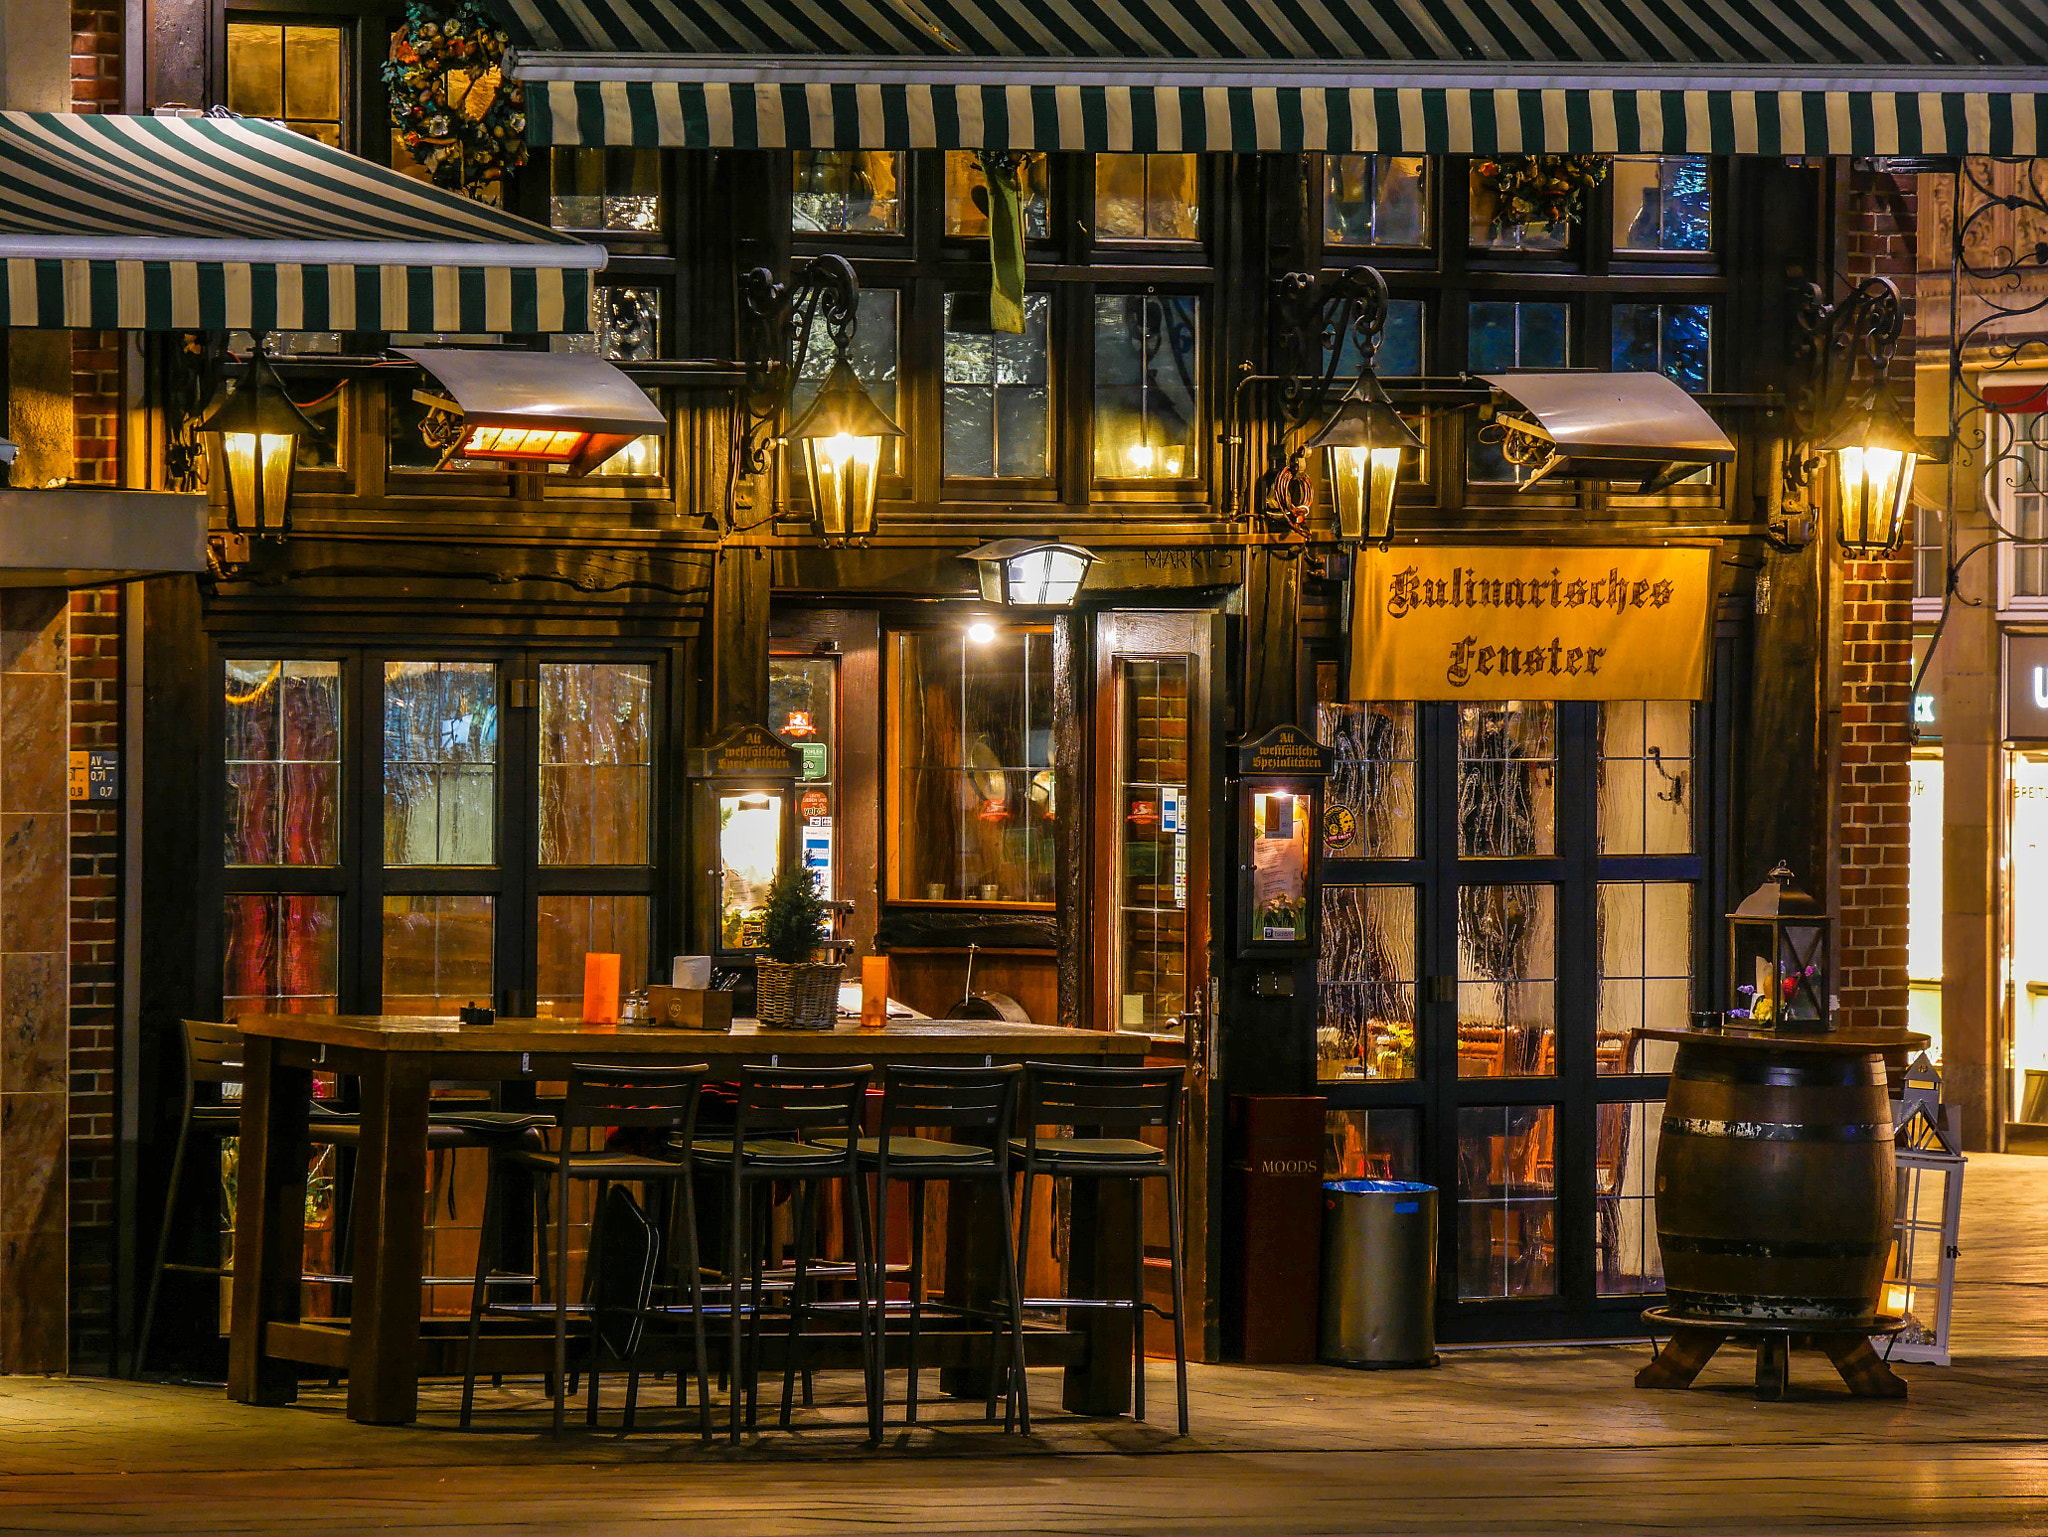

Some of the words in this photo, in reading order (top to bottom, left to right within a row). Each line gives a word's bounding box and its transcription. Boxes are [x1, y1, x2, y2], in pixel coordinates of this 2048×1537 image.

[1145, 549, 1213, 569] MARKT
[1387, 565, 1674, 619] Kulinarisches
[1447, 635, 1607, 687] Fenster
[745, 733, 761, 744] Alt
[1280, 732, 1295, 744] Alt
[725, 745, 787, 758] westfälische
[1260, 744, 1319, 757] westfälische
[91, 756, 102, 766] AV
[1252, 756, 1322, 771] Spezialitäten
[100, 787, 113, 798] 0,7
[804, 807, 820, 817] yelp
[1262, 1160, 1317, 1173] MOODS
